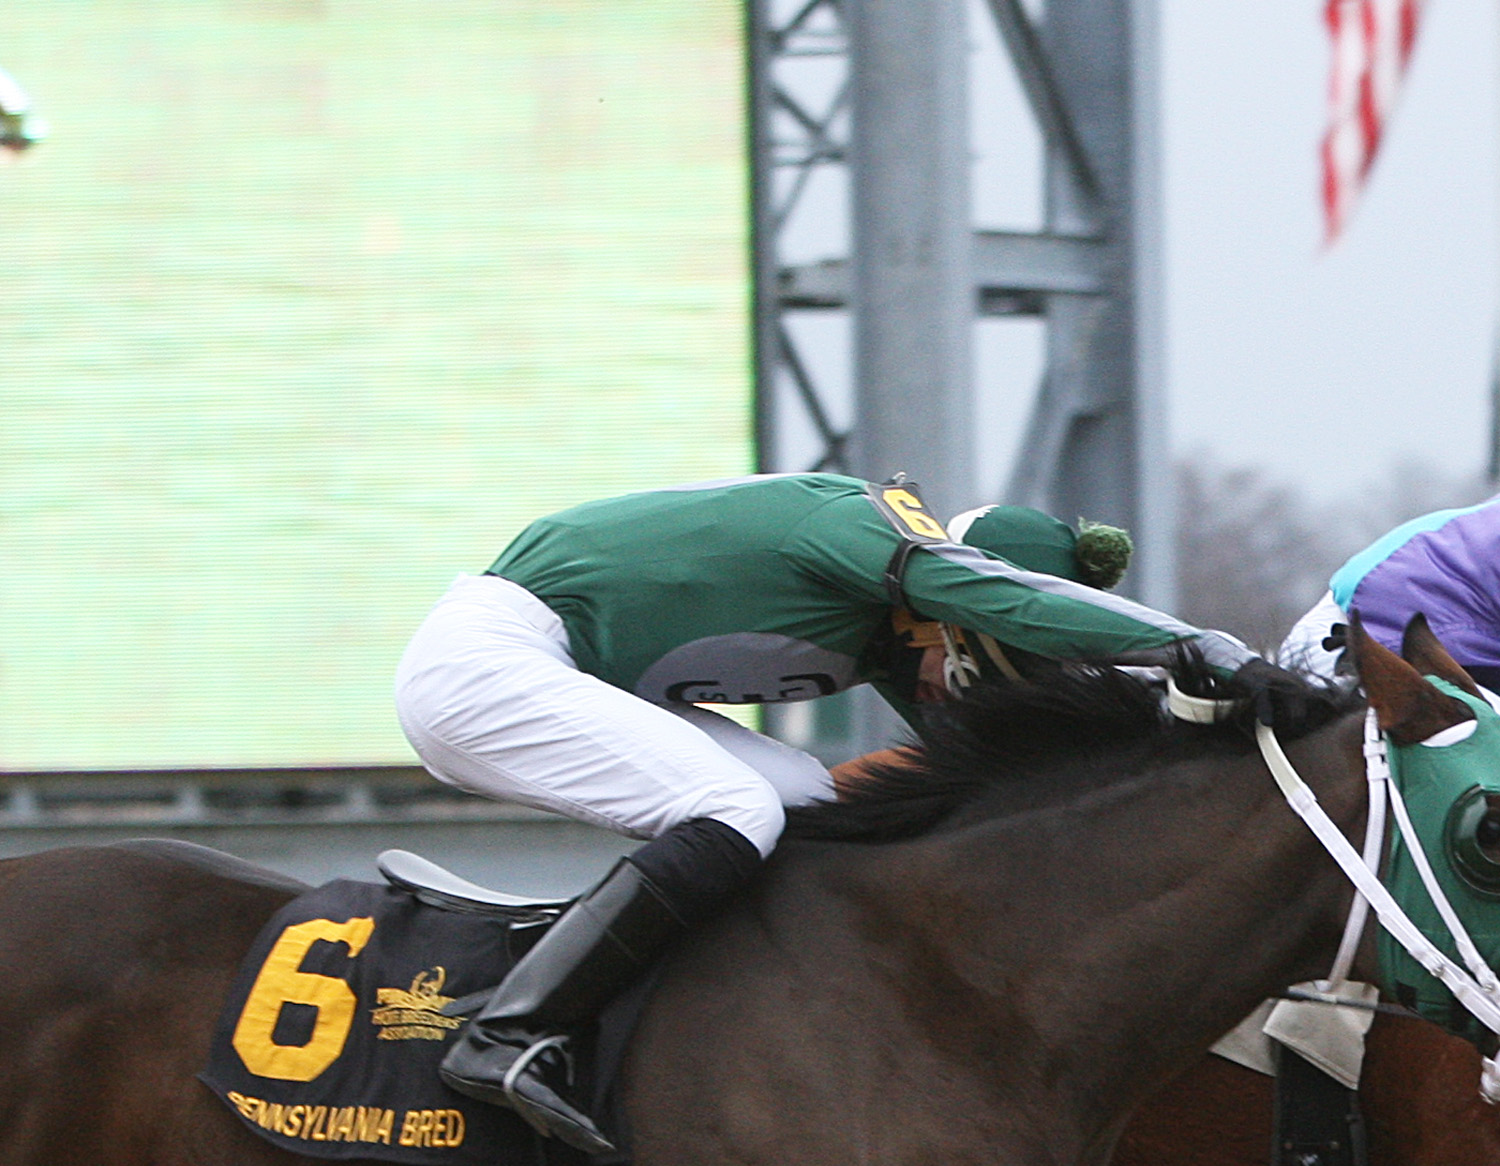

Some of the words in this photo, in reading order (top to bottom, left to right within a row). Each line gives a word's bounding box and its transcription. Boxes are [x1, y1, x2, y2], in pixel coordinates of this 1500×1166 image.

[883, 489, 948, 540] 6
[232, 915, 376, 1082] 6
[227, 1090, 397, 1146] PENNSYLVANIA
[398, 1108, 467, 1149] BRED
